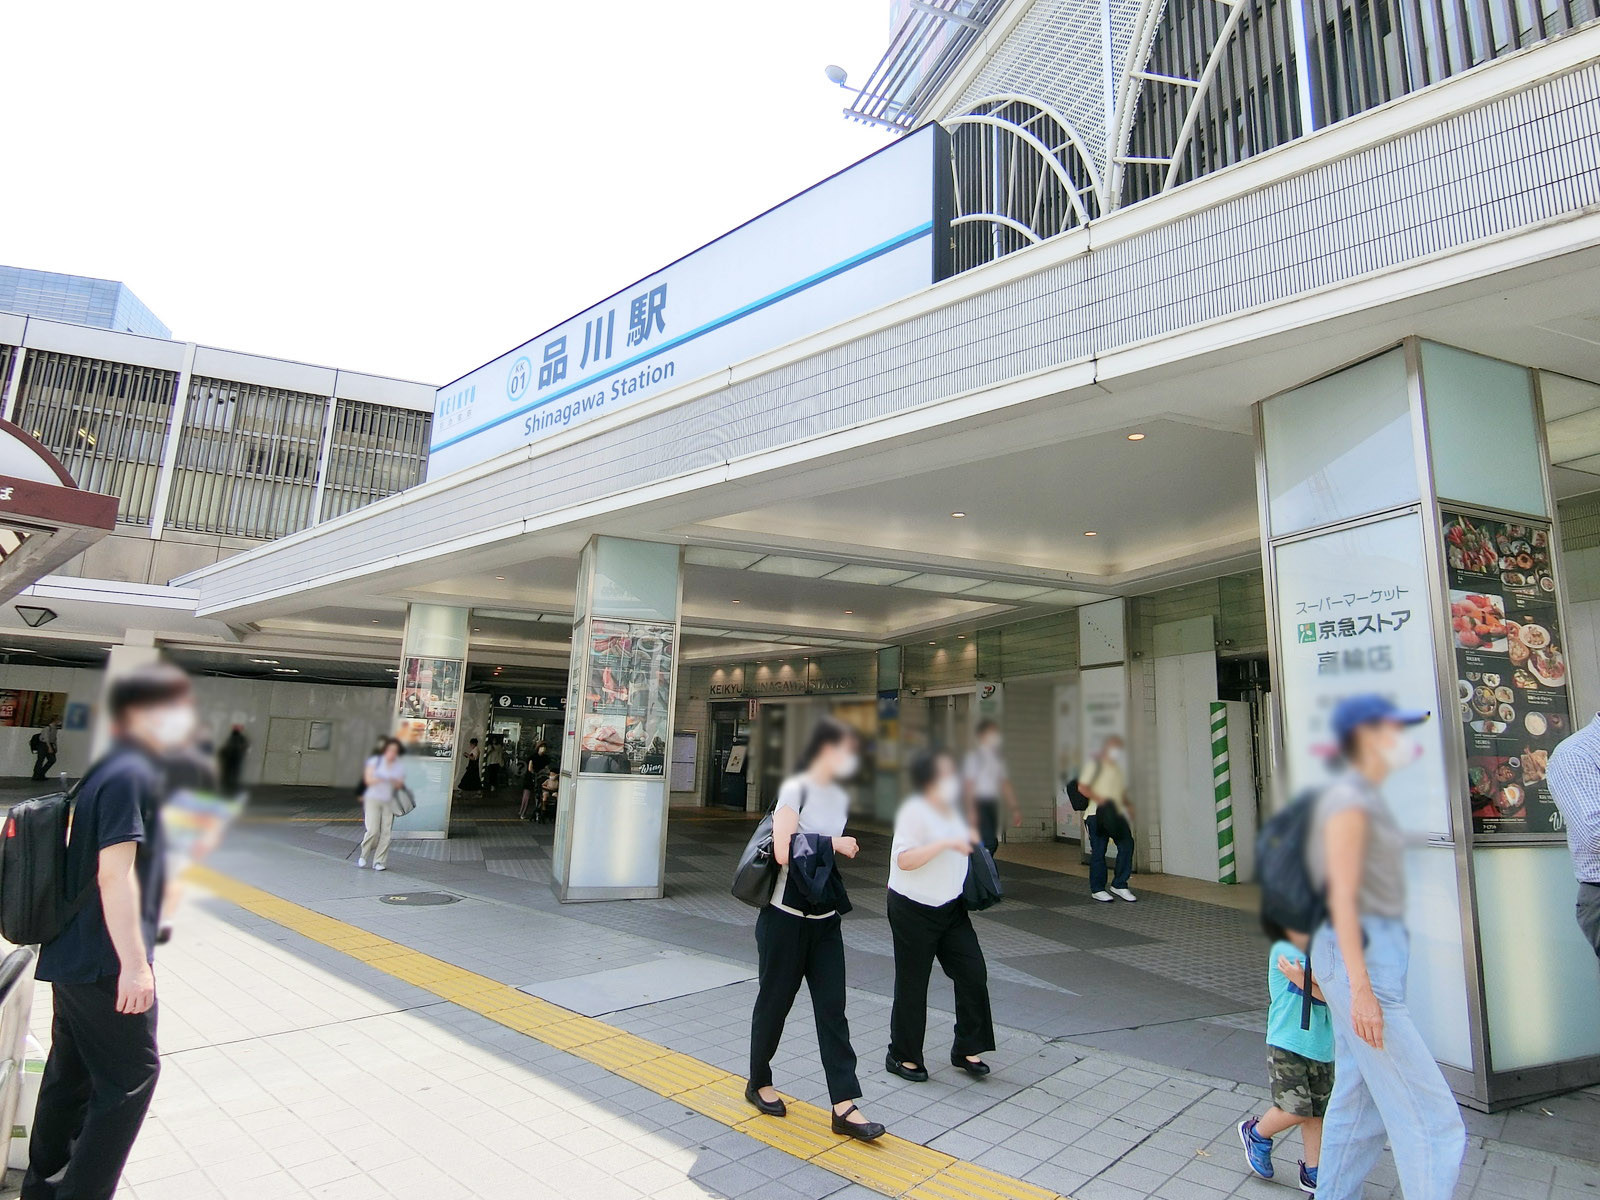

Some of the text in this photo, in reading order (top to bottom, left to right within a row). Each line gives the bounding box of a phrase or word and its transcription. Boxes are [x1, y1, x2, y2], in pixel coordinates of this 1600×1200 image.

[538, 282, 668, 391] 品川駅
[510, 371, 526, 395] 01
[524, 361, 675, 437] Shinagawa Station
[1296, 585, 1409, 615] スーパーマーケット
[1318, 609, 1411, 640] 京急ストア
[526, 696, 547, 706] TIC
[710, 684, 743, 695] KEIKYU
[746, 679, 805, 693] INAGAWA
